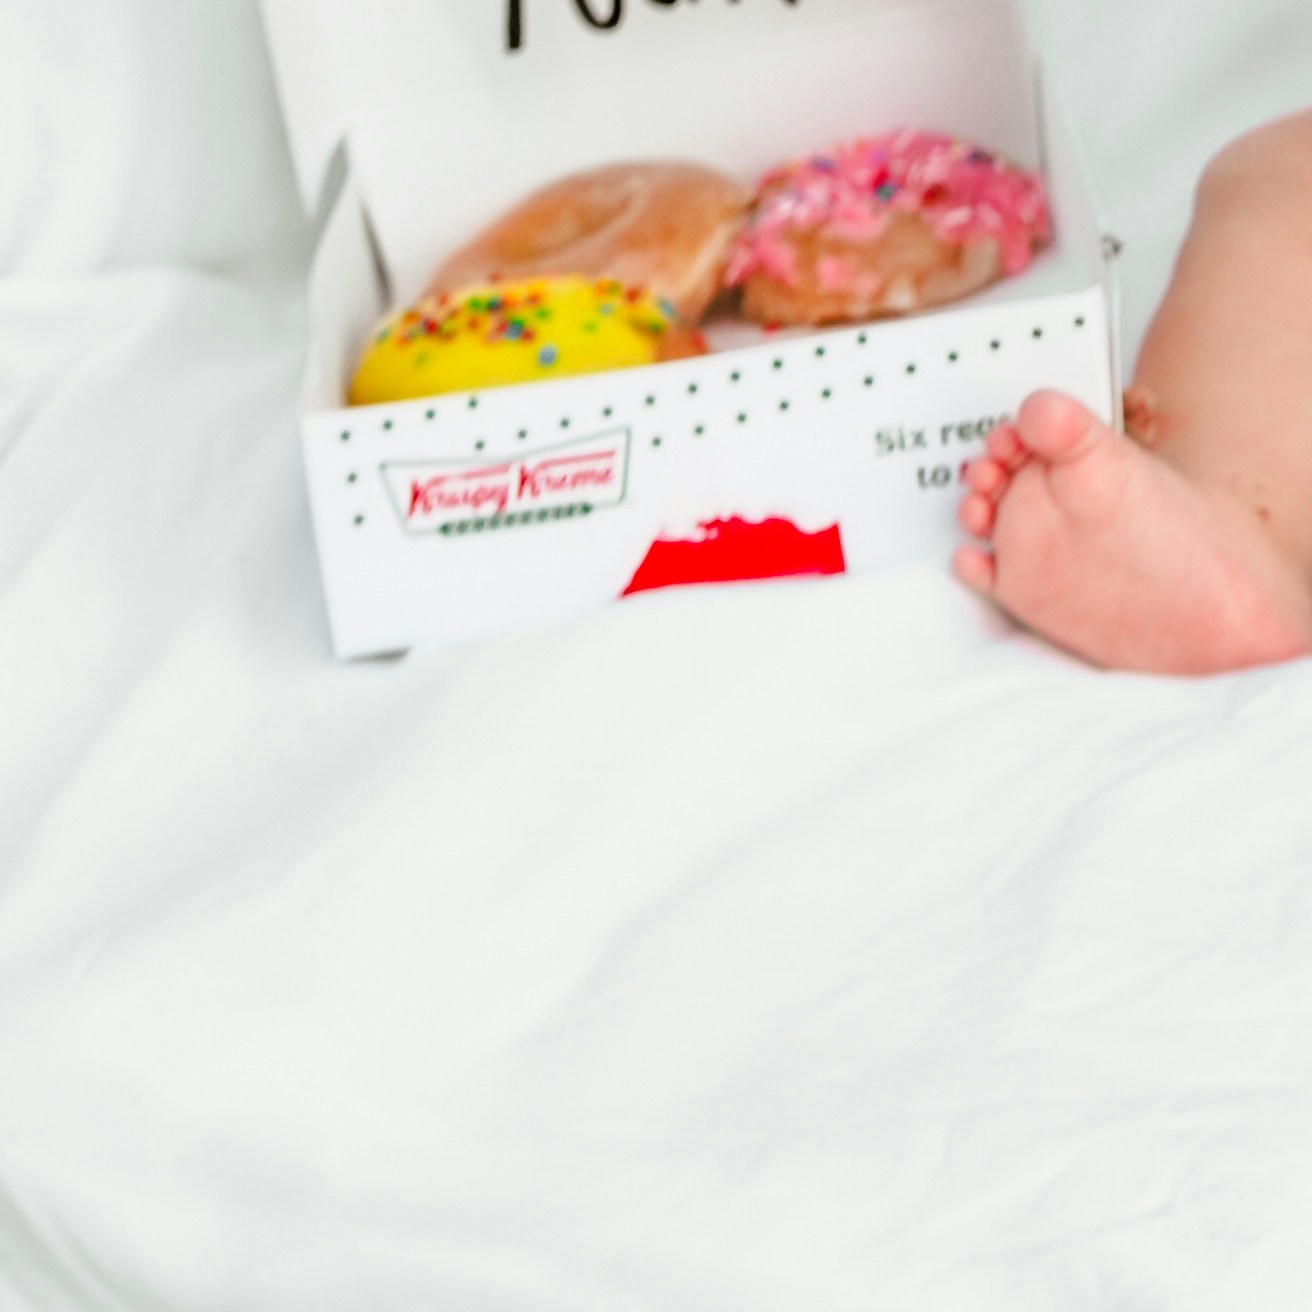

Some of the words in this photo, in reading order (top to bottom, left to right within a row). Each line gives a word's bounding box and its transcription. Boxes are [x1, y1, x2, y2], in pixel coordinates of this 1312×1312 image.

[874, 425, 927, 454] Six
[939, 414, 1012, 445] rea
[916, 465, 952, 489] to
